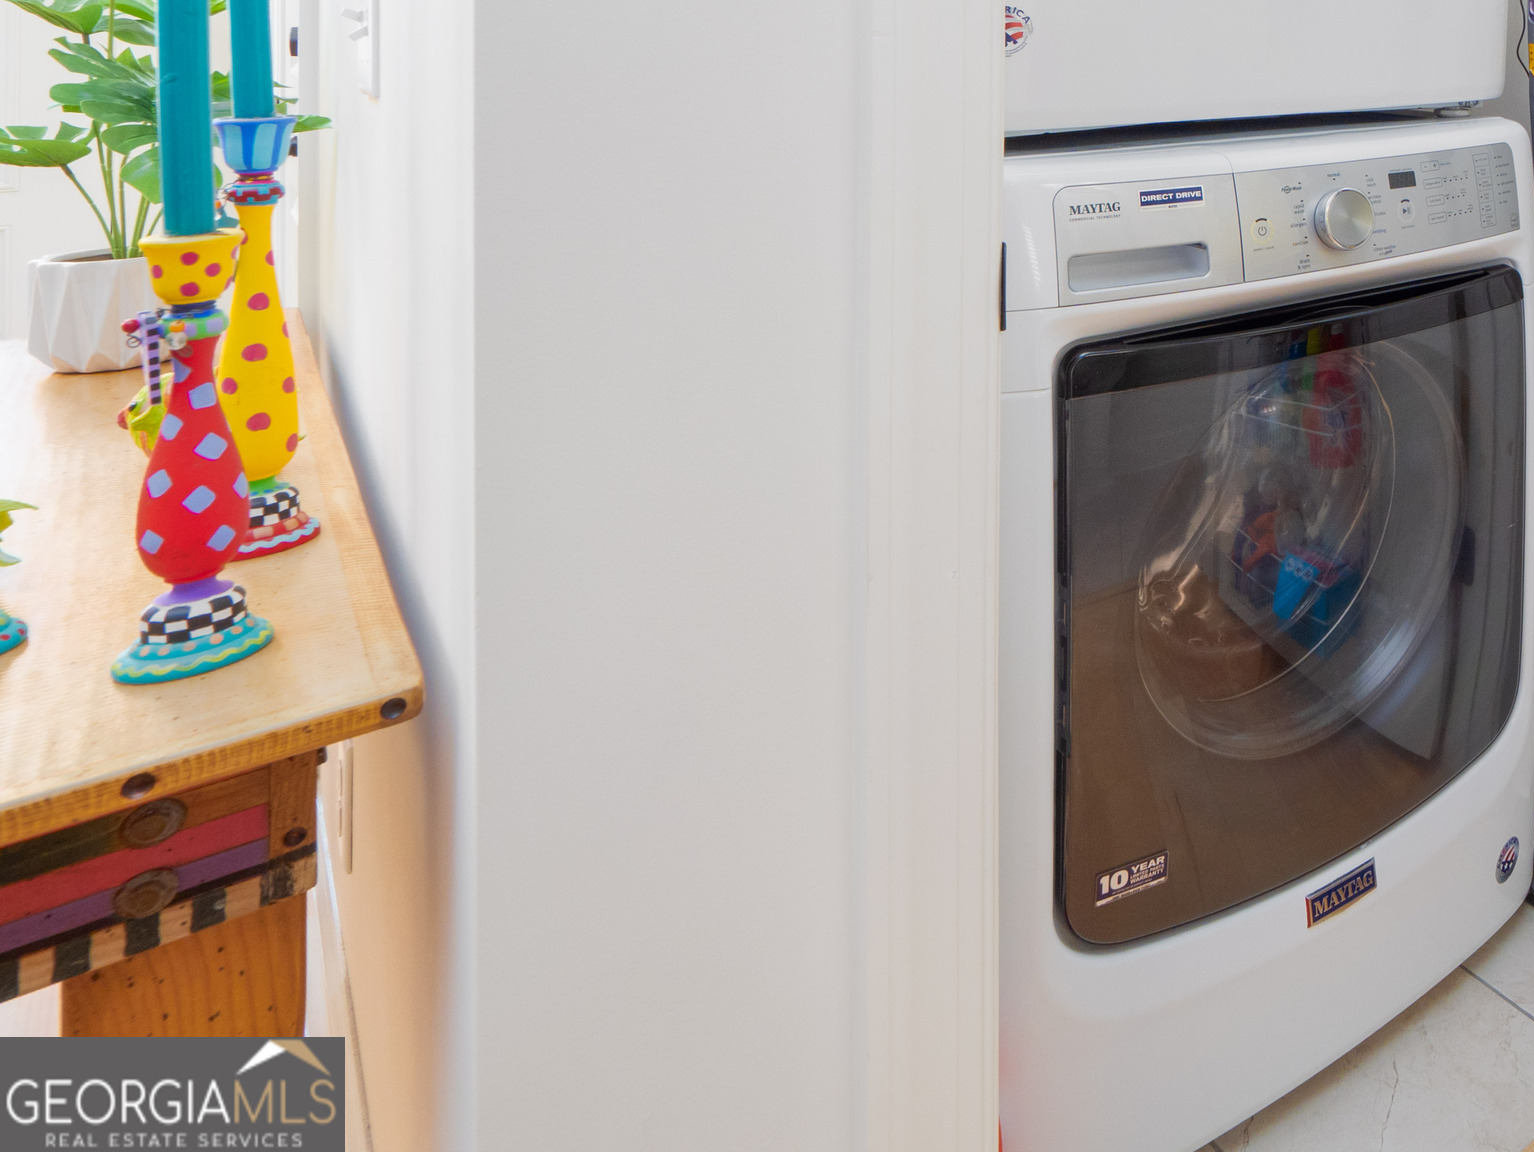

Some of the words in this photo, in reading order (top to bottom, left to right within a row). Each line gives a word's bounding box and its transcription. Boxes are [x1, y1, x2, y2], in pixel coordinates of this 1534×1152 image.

[1005, 5, 1030, 24] RICA
[1142, 193, 1173, 202] DIRECT
[1176, 191, 1202, 199] DRIVE
[1069, 202, 1120, 215] MAYTAG
[1131, 856, 1165, 874] YEAR
[1100, 869, 1129, 895] 10
[1130, 869, 1164, 884] WARRANTY
[1313, 869, 1374, 919] MAYTAG
